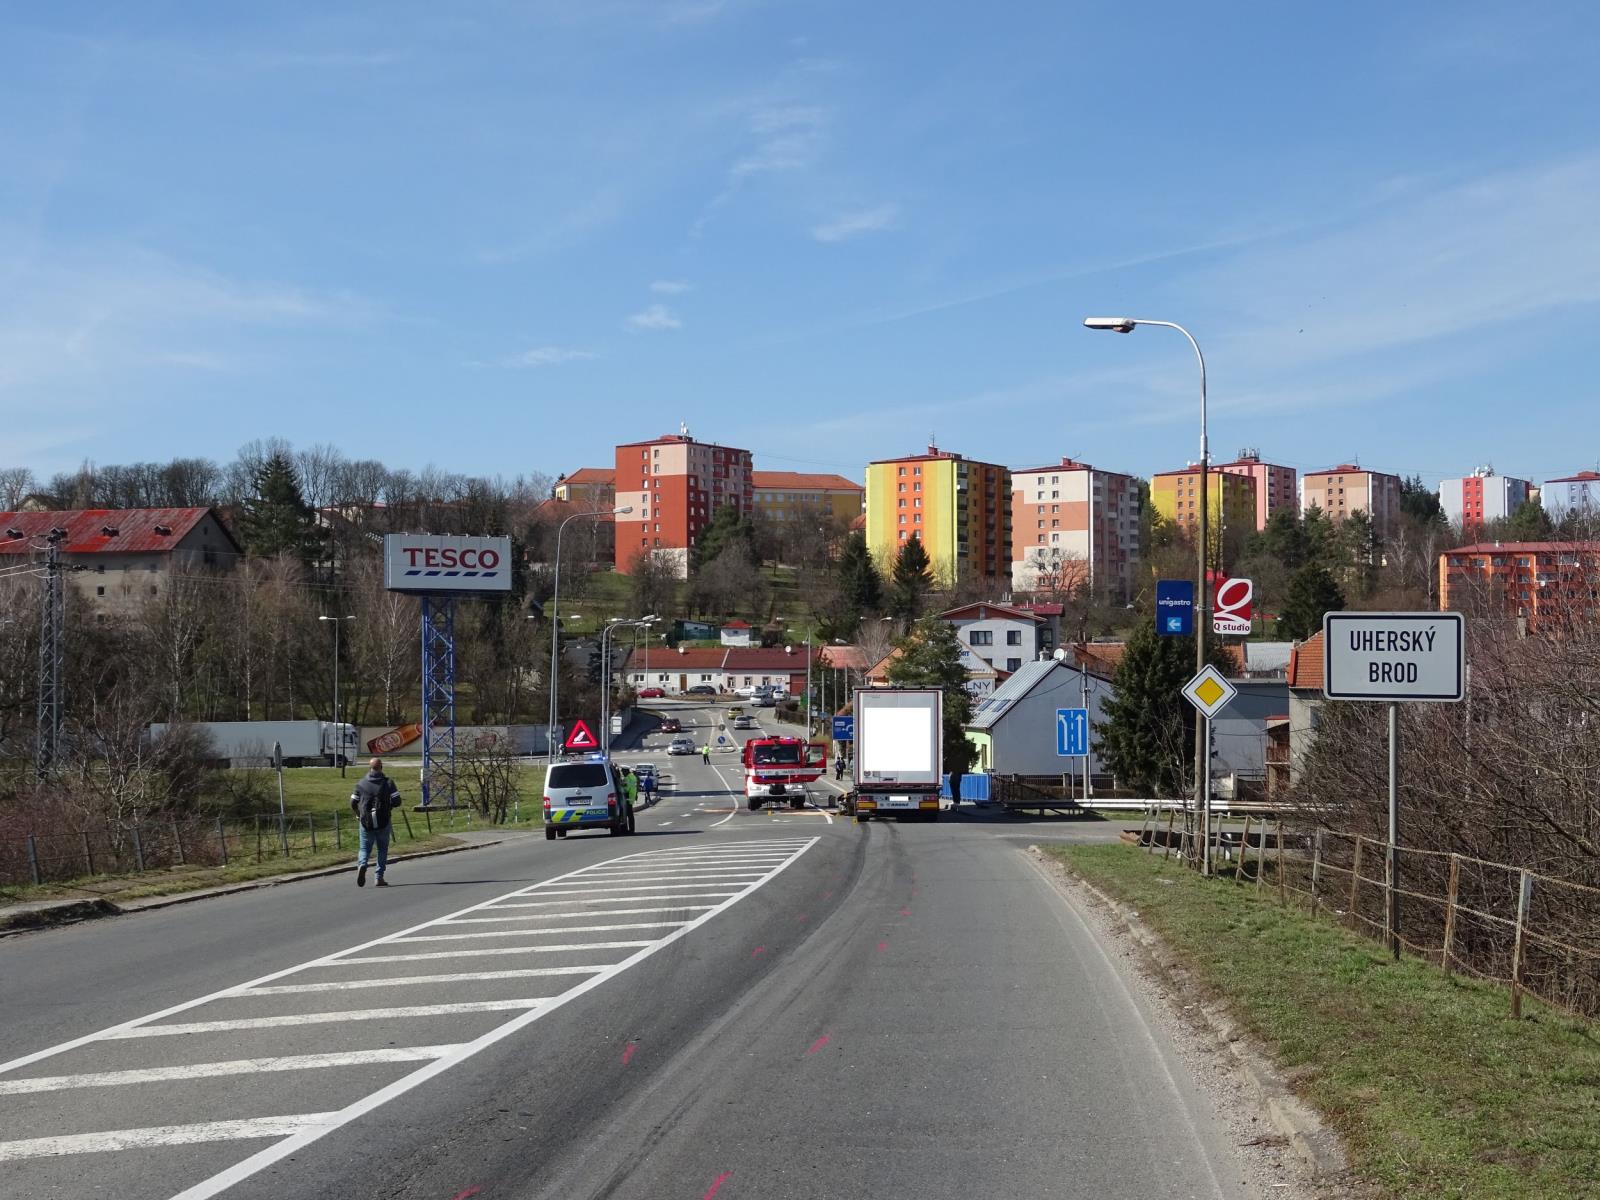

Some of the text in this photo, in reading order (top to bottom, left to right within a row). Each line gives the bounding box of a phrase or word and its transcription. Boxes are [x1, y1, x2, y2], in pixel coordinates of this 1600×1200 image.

[402, 547, 500, 570] TESCO
[1158, 596, 1191, 607] unigastro
[1213, 622, 1250, 632] Q studio
[1350, 625, 1437, 652] UHERSKÝ
[1369, 662, 1418, 684] BROD
[965, 681, 991, 690] LNY
